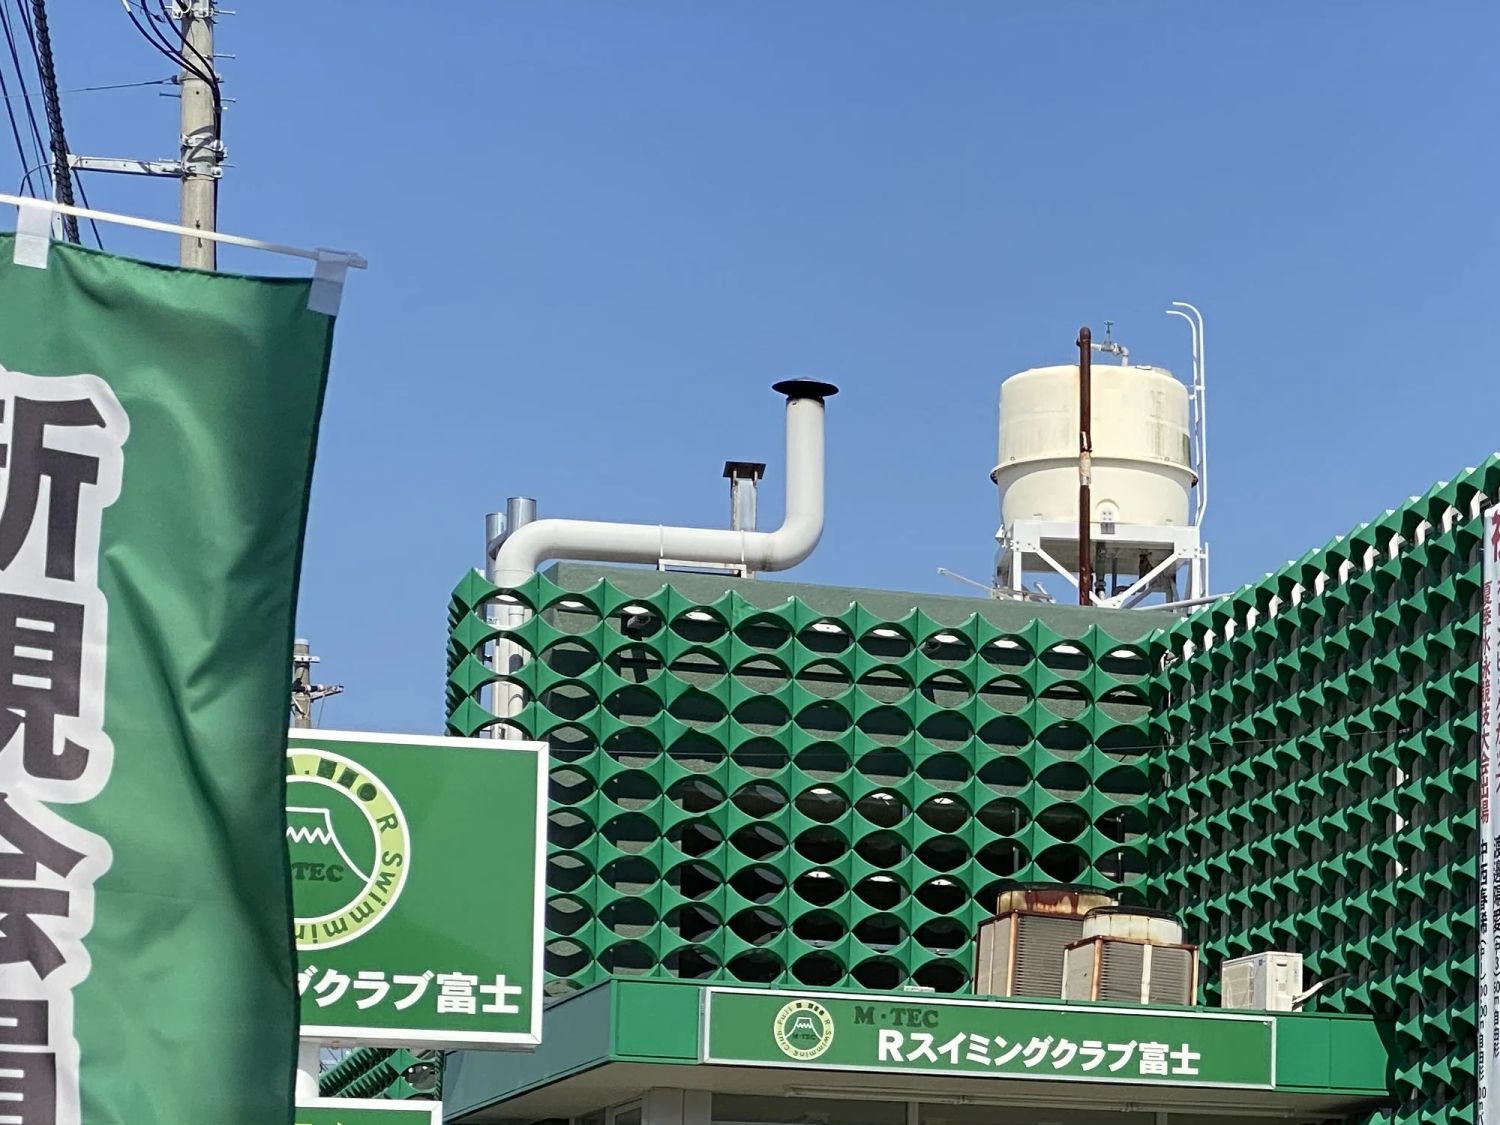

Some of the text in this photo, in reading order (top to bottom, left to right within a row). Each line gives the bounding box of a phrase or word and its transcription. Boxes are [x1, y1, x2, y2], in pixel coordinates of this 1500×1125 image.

[878, 1029, 1200, 1075] Rスイミングクラブ富士
